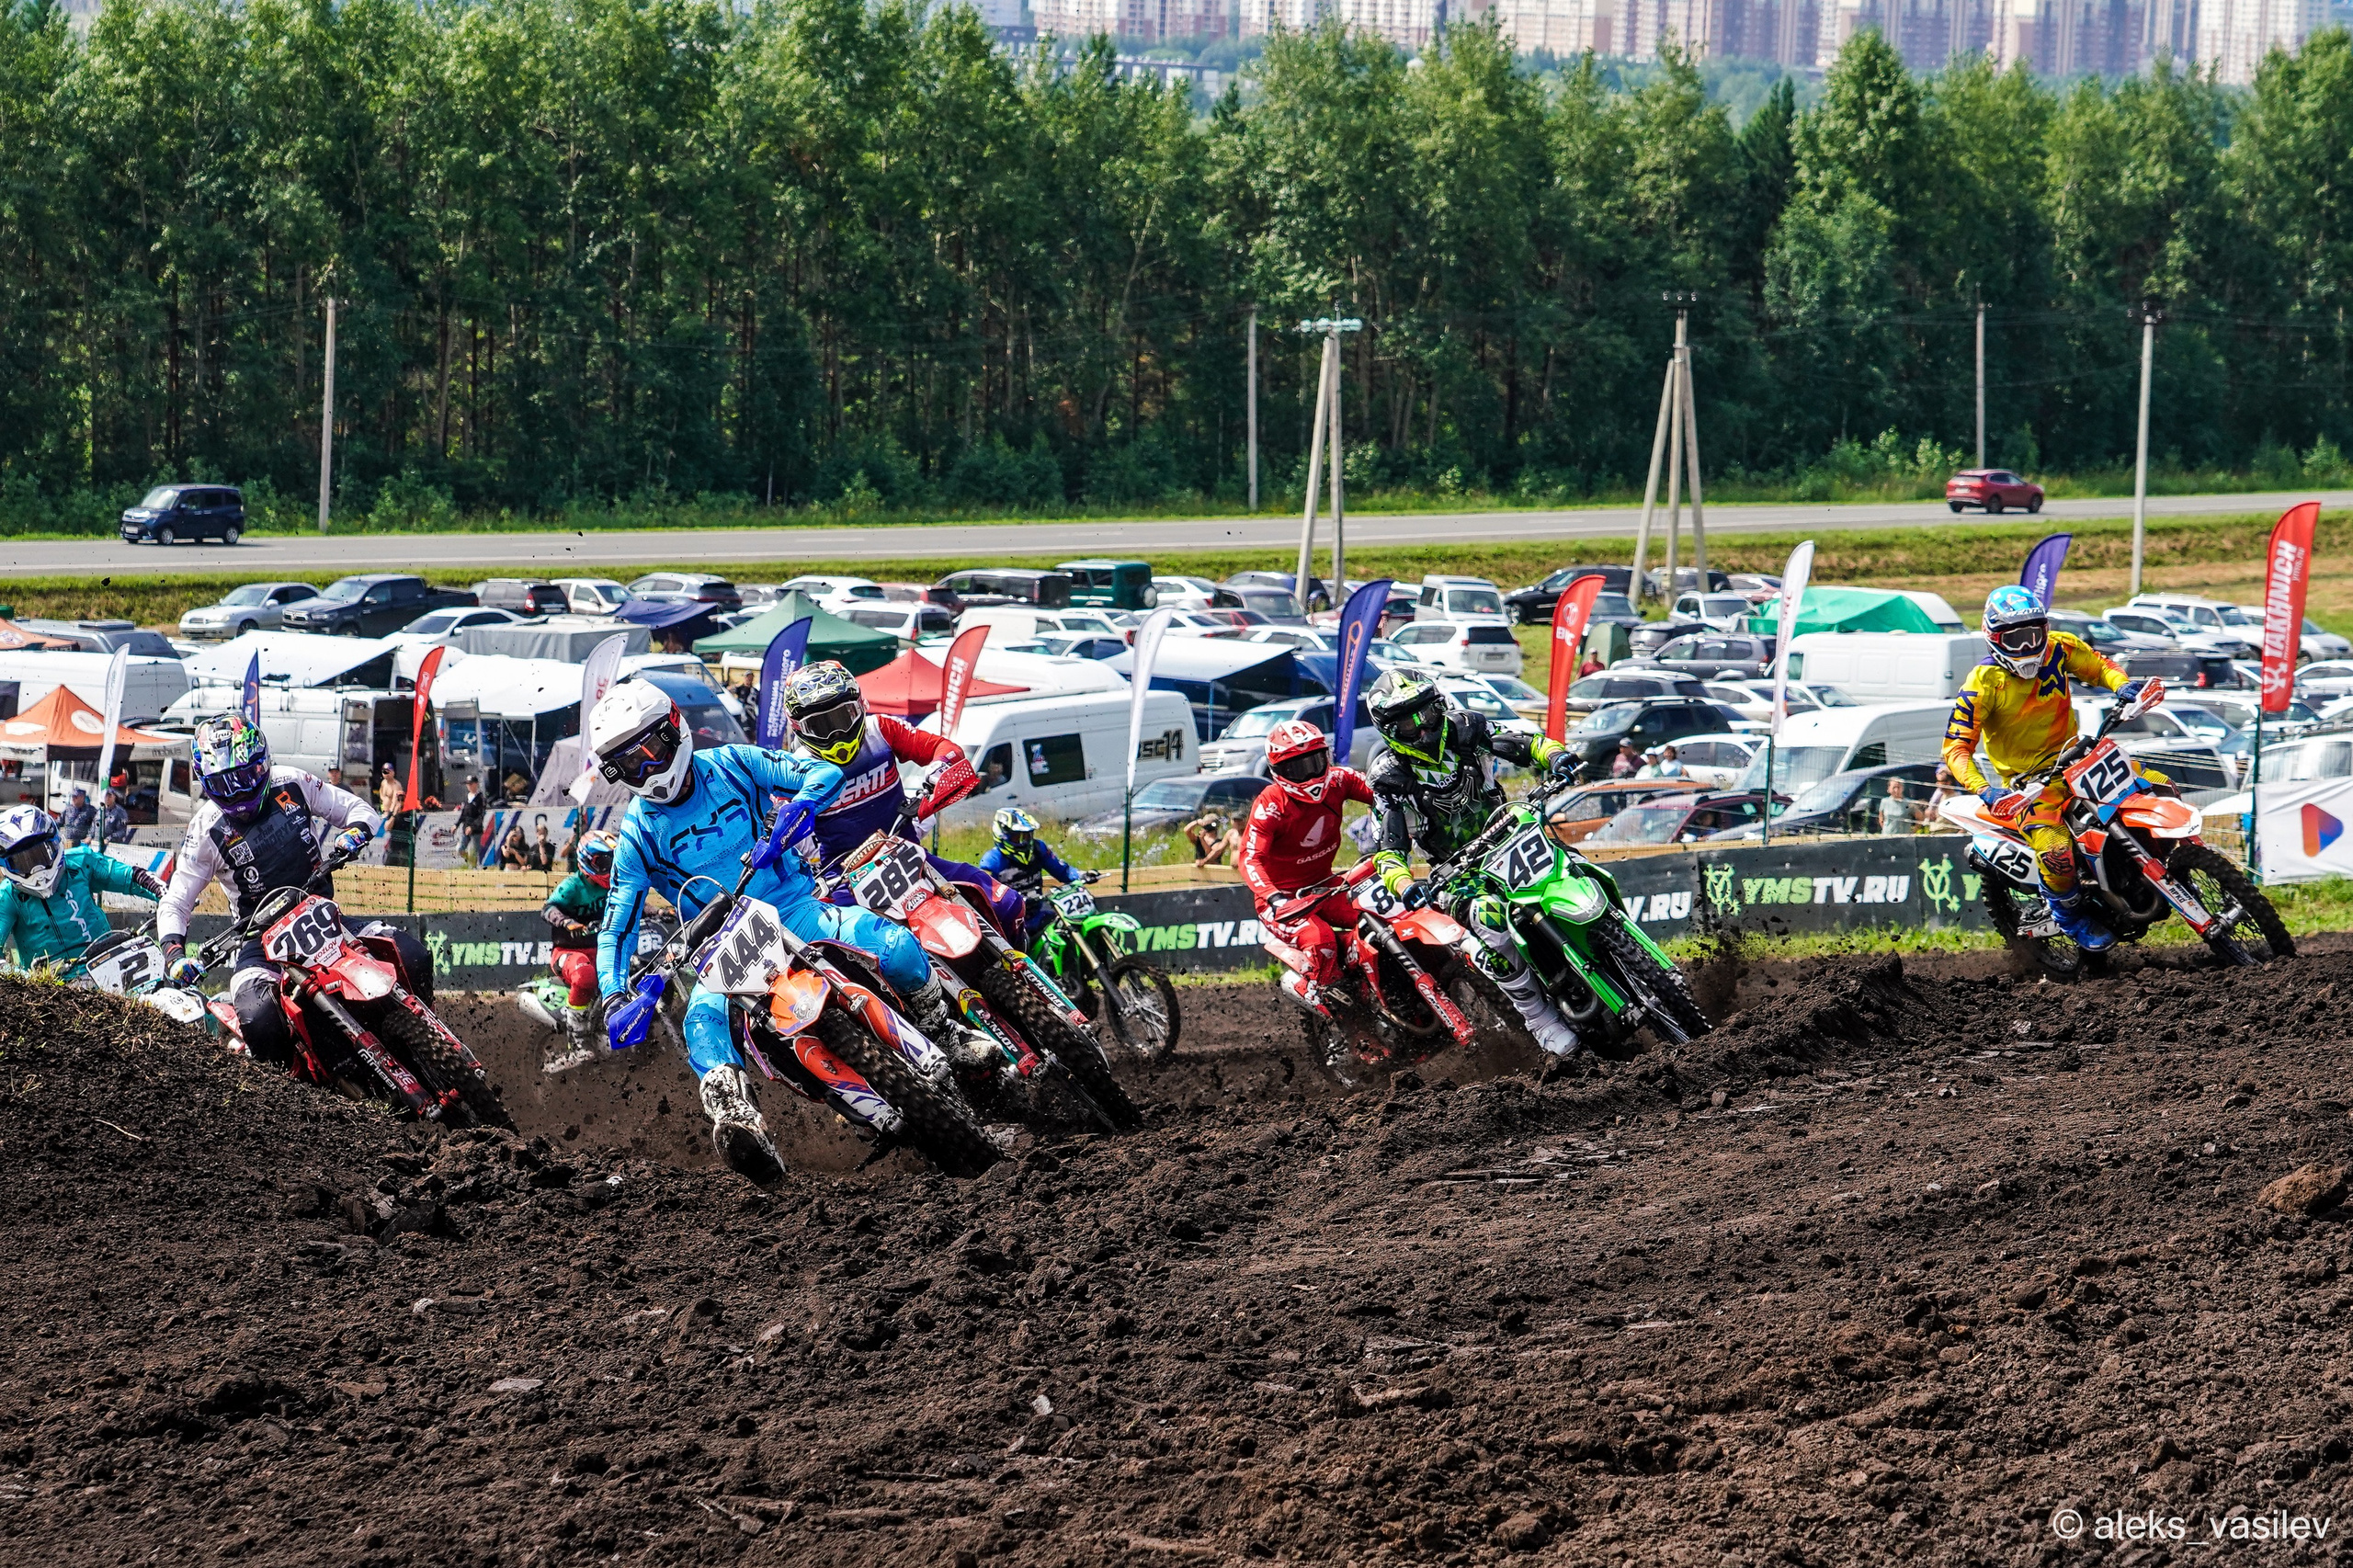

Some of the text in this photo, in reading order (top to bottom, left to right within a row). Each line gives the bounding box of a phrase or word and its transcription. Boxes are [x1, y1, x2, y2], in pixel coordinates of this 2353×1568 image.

[2265, 540, 2298, 659] TAKHNICH
[941, 655, 965, 736] KHNICH
[2080, 749, 2131, 801] 125
[780, 809, 808, 845] Polisport
[1296, 841, 1338, 866] GASGAS
[1507, 834, 1553, 892] 42
[1988, 840, 2033, 880] 125
[861, 845, 923, 913] 285
[1742, 875, 1911, 905] YMSTV.RU
[1063, 894, 1091, 915] 224
[273, 901, 344, 966] 269
[313, 938, 338, 961] KOZLOV
[451, 940, 553, 966] YMSTV.R
[721, 912, 779, 990] 444
[118, 951, 150, 991] 2
[620, 1006, 646, 1042] Polisport
